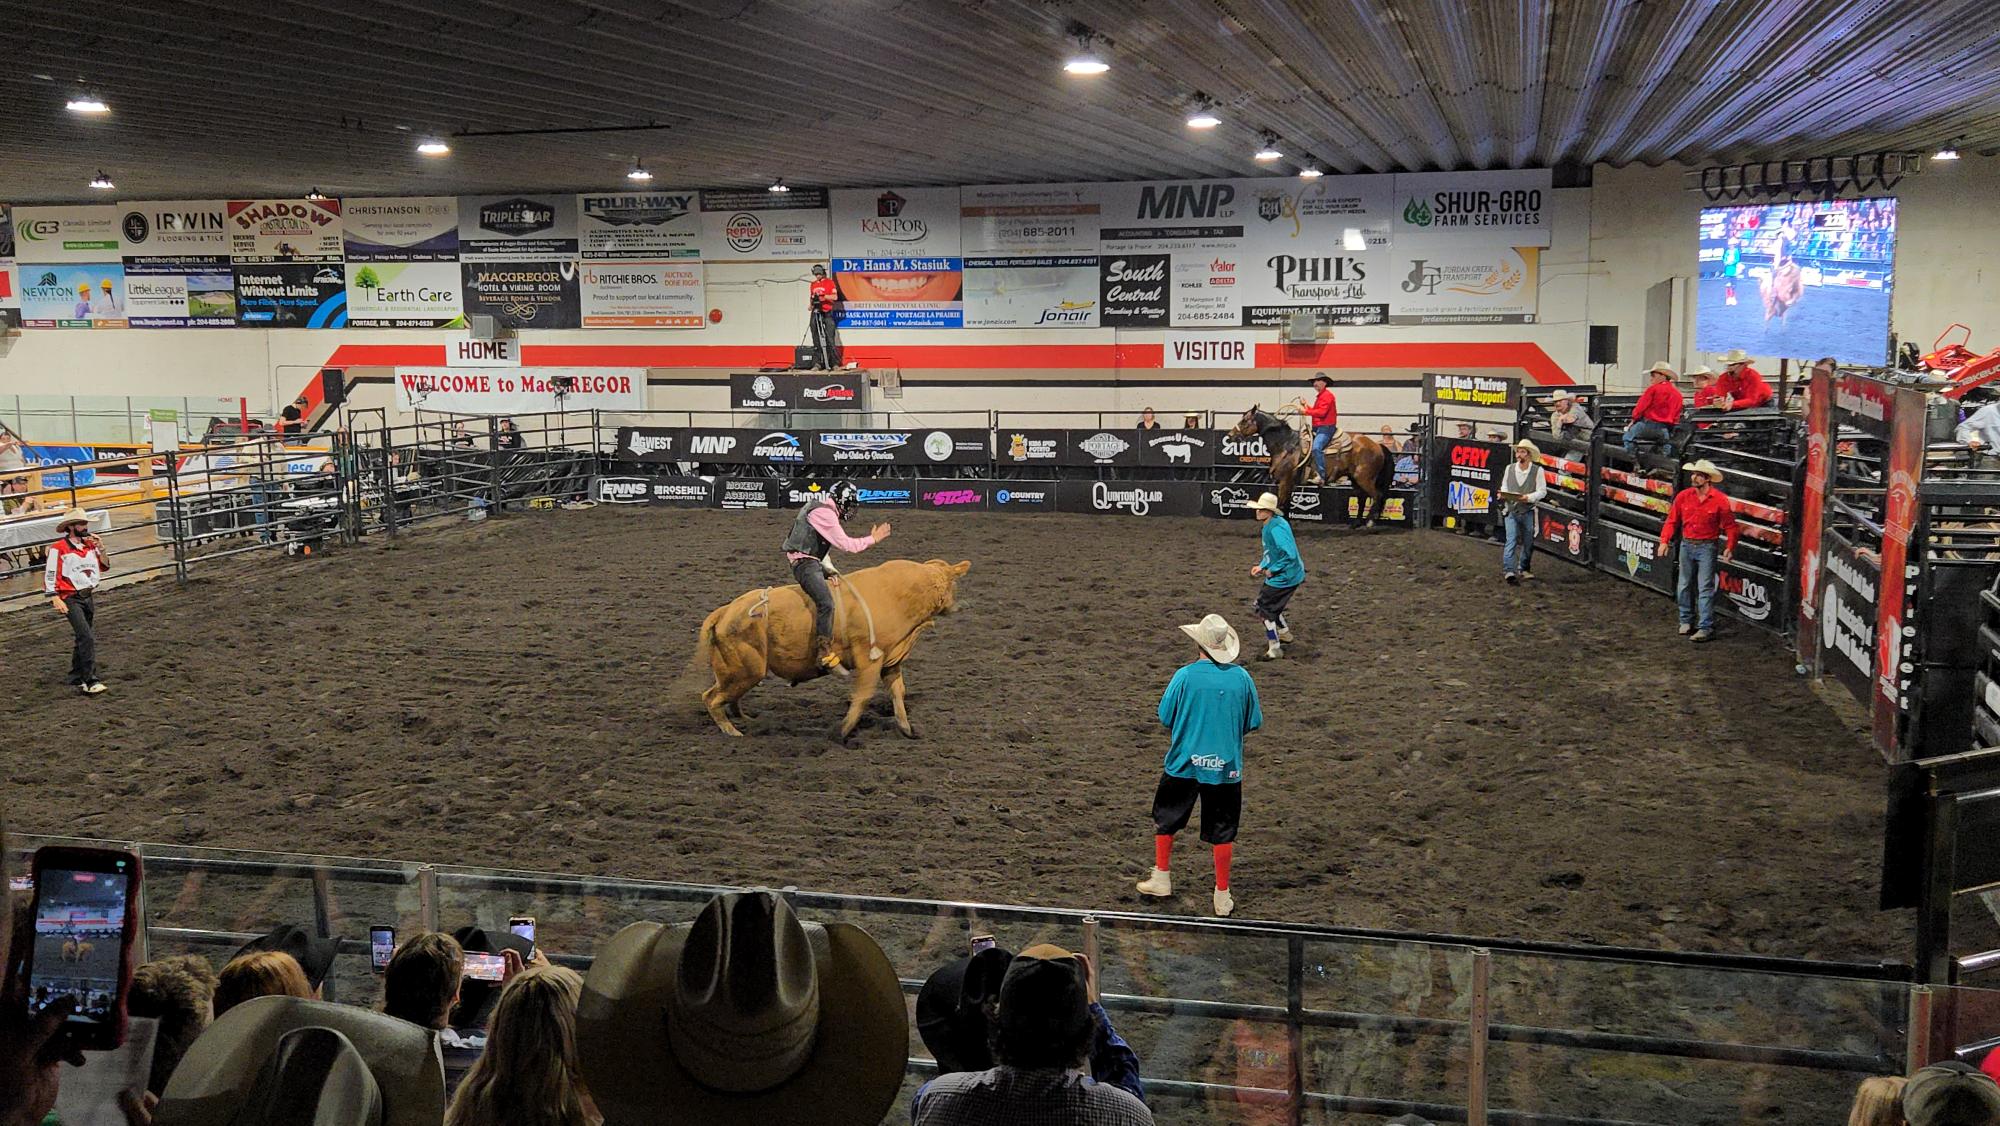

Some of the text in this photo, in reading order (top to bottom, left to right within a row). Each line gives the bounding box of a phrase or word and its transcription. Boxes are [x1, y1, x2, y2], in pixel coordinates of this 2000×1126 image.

[1137, 184, 1235, 219] MNP
[1434, 189, 1542, 215] SHUR-GRO
[236, 203, 333, 230] SHADOW
[349, 206, 421, 215] CHRISTIANSON
[156, 212, 223, 230] IRWIN
[1434, 213, 1540, 226] FARM SERVICES
[35, 221, 59, 234] G3
[1023, 226, 1075, 237] 685-2011
[843, 259, 950, 271] Dr. Hans M. Stasiuk
[1106, 260, 1165, 282] South
[1209, 257, 1236, 272] Valor
[1443, 265, 1494, 273] JORDAN CREEK
[240, 274, 283, 285] Internet
[478, 272, 560, 282] MACGREGOR
[600, 274, 658, 285] RITCHIE BROS.
[1442, 273, 1482, 281] TRANSPORT
[22, 287, 73, 297] NEWTON
[240, 285, 319, 297] Without Limits
[377, 287, 453, 302] Earth Care
[478, 284, 500, 292] HOTEL
[509, 284, 534, 292] VIKING
[539, 284, 561, 292] ROOM
[1106, 286, 1162, 302] Central
[1331, 307, 1352, 315] STEP
[1353, 306, 1381, 315] DECKS
[459, 342, 508, 359] HOME
[1173, 341, 1245, 361] VISITOR
[400, 374, 631, 394] WELCOME to MacREGOR
[1435, 375, 1508, 391] Bull Bash Thrives
[1437, 388, 1506, 405] with Your Support!
[690, 436, 736, 454] MNP
[753, 446, 796, 456] RFNOW
[1451, 445, 1491, 469] CFRY
[602, 483, 647, 495] ENNS
[663, 485, 708, 495] ROSEHILL
[1010, 491, 1045, 500] COUNTRY
[1288, 512, 1323, 521] Homestead
[1615, 531, 1654, 560] PORTAGE
